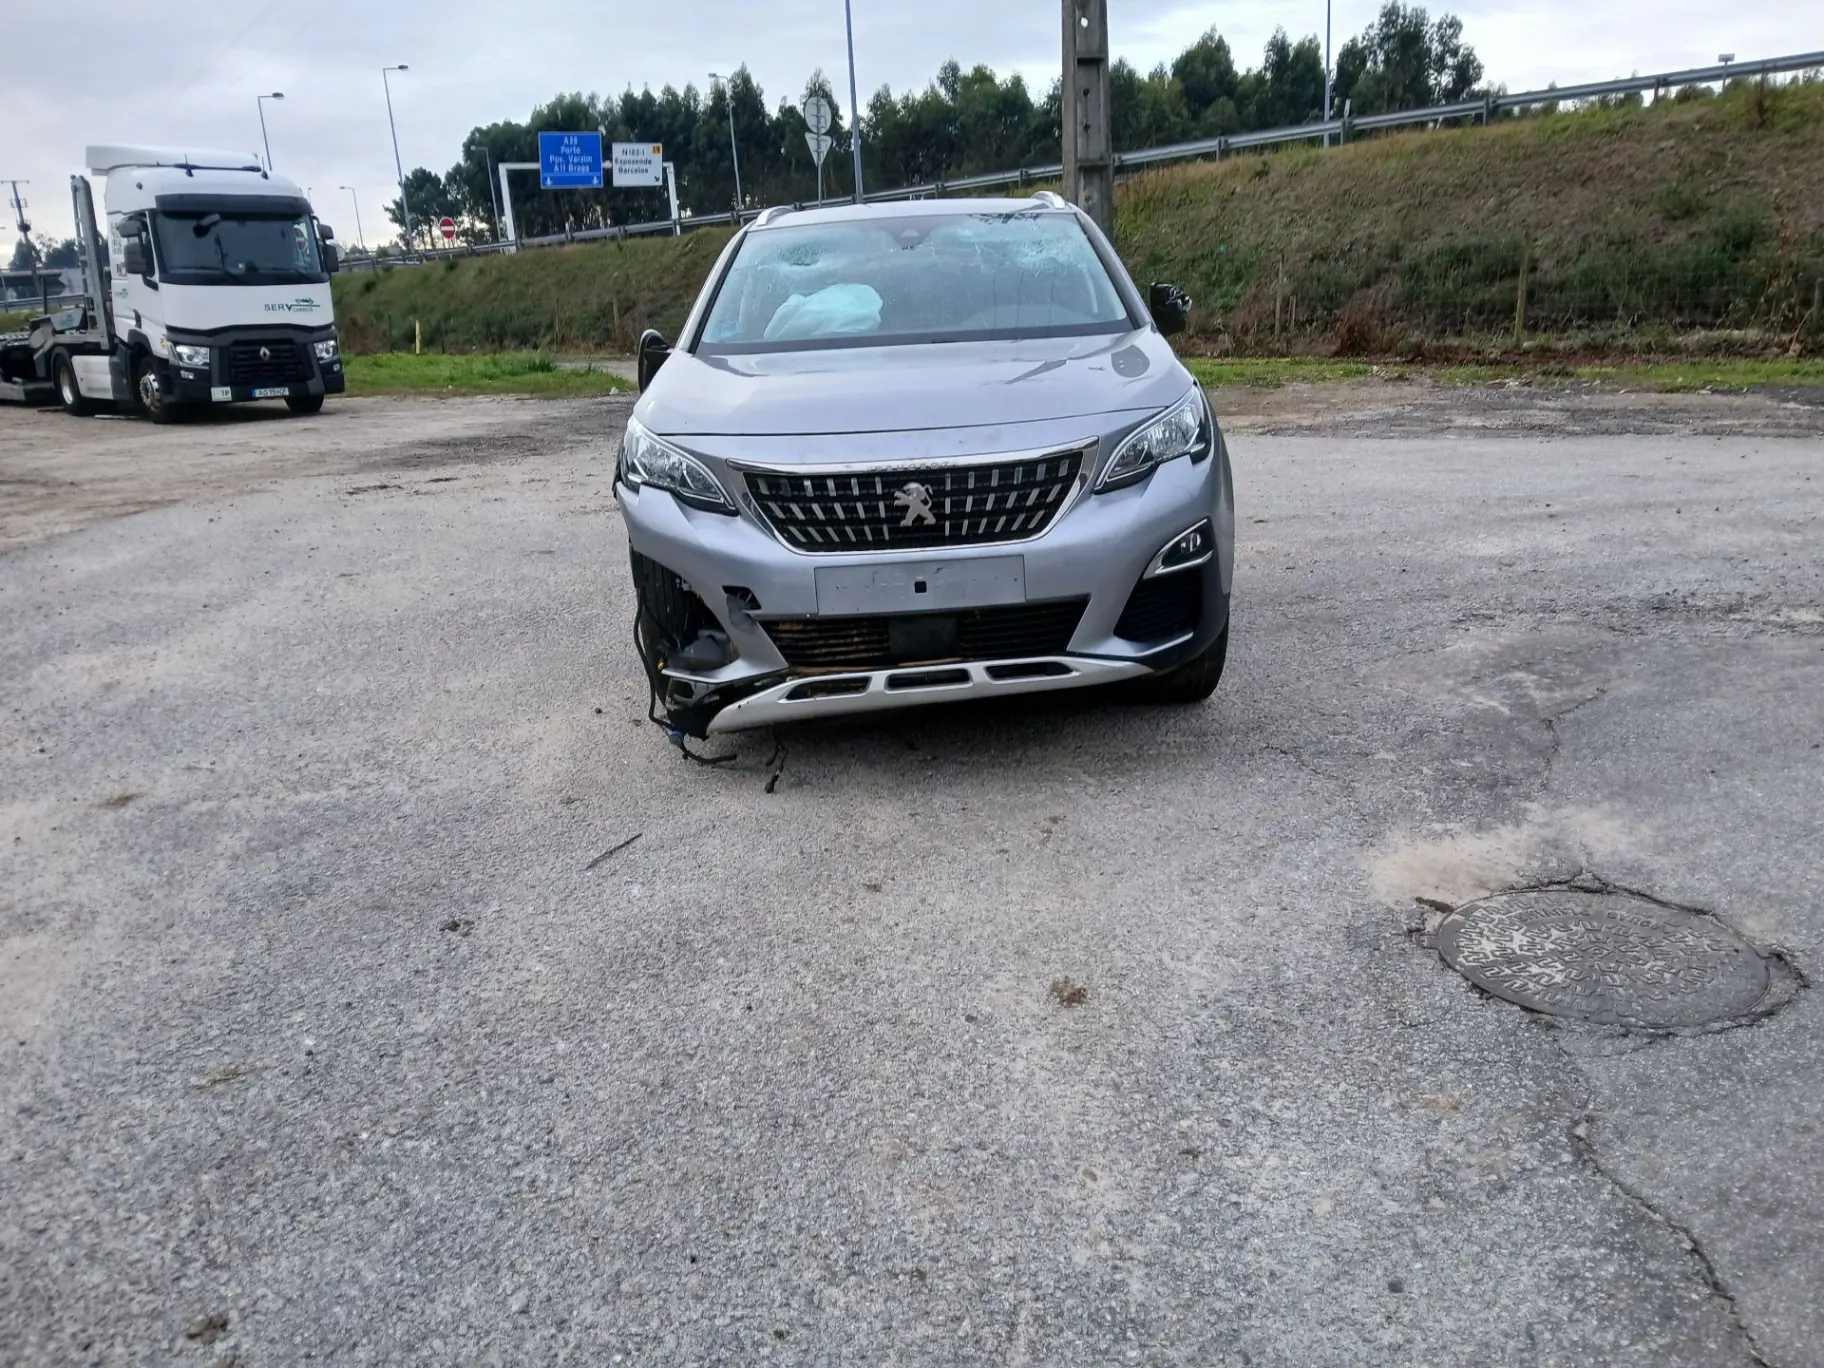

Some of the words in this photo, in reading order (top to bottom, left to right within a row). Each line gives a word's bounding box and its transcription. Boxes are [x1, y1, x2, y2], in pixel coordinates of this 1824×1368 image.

[561, 145, 580, 154] Porto
[568, 154, 593, 164] Varzim
[614, 157, 652, 165] Esposende
[568, 163, 590, 174] Braga
[618, 166, 649, 174] Barcelos
